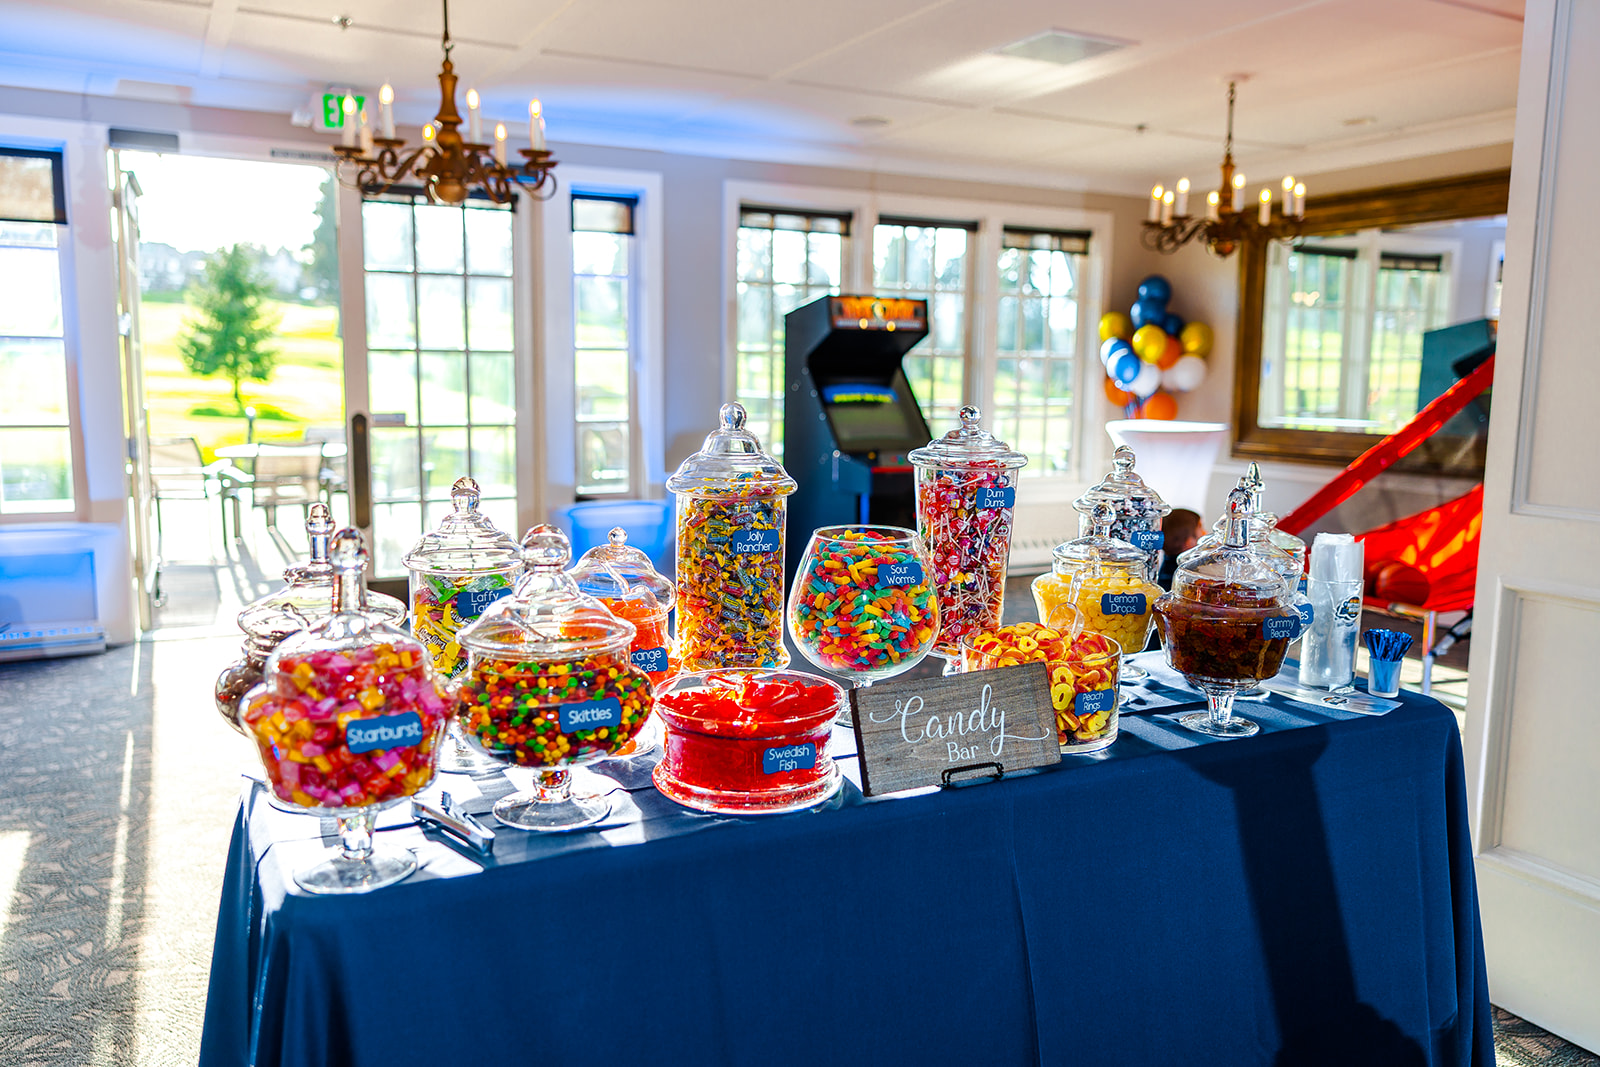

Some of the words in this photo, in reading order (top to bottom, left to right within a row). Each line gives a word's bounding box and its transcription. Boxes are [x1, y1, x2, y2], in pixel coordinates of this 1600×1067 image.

[986, 488, 1005, 498] Dum
[984, 498, 1005, 508] Dums
[746, 531, 765, 544] Jolly
[736, 542, 773, 552] Rancher
[890, 564, 908, 575] Sour
[885, 575, 916, 585] Worms
[470, 590, 500, 604] Laffy
[1108, 594, 1139, 604] Lemon
[1110, 603, 1137, 615] Drops
[1267, 618, 1295, 630] Gummy
[1270, 628, 1290, 639] Bears
[631, 649, 662, 663] range
[1082, 691, 1105, 702] Peach
[1083, 701, 1101, 713] Rings
[568, 707, 613, 725] Skittles
[869, 683, 1050, 757] Candy
[347, 721, 422, 746] Starburst
[768, 744, 810, 761] Swedish
[946, 741, 980, 763] Bar
[779, 758, 798, 772] Fish
